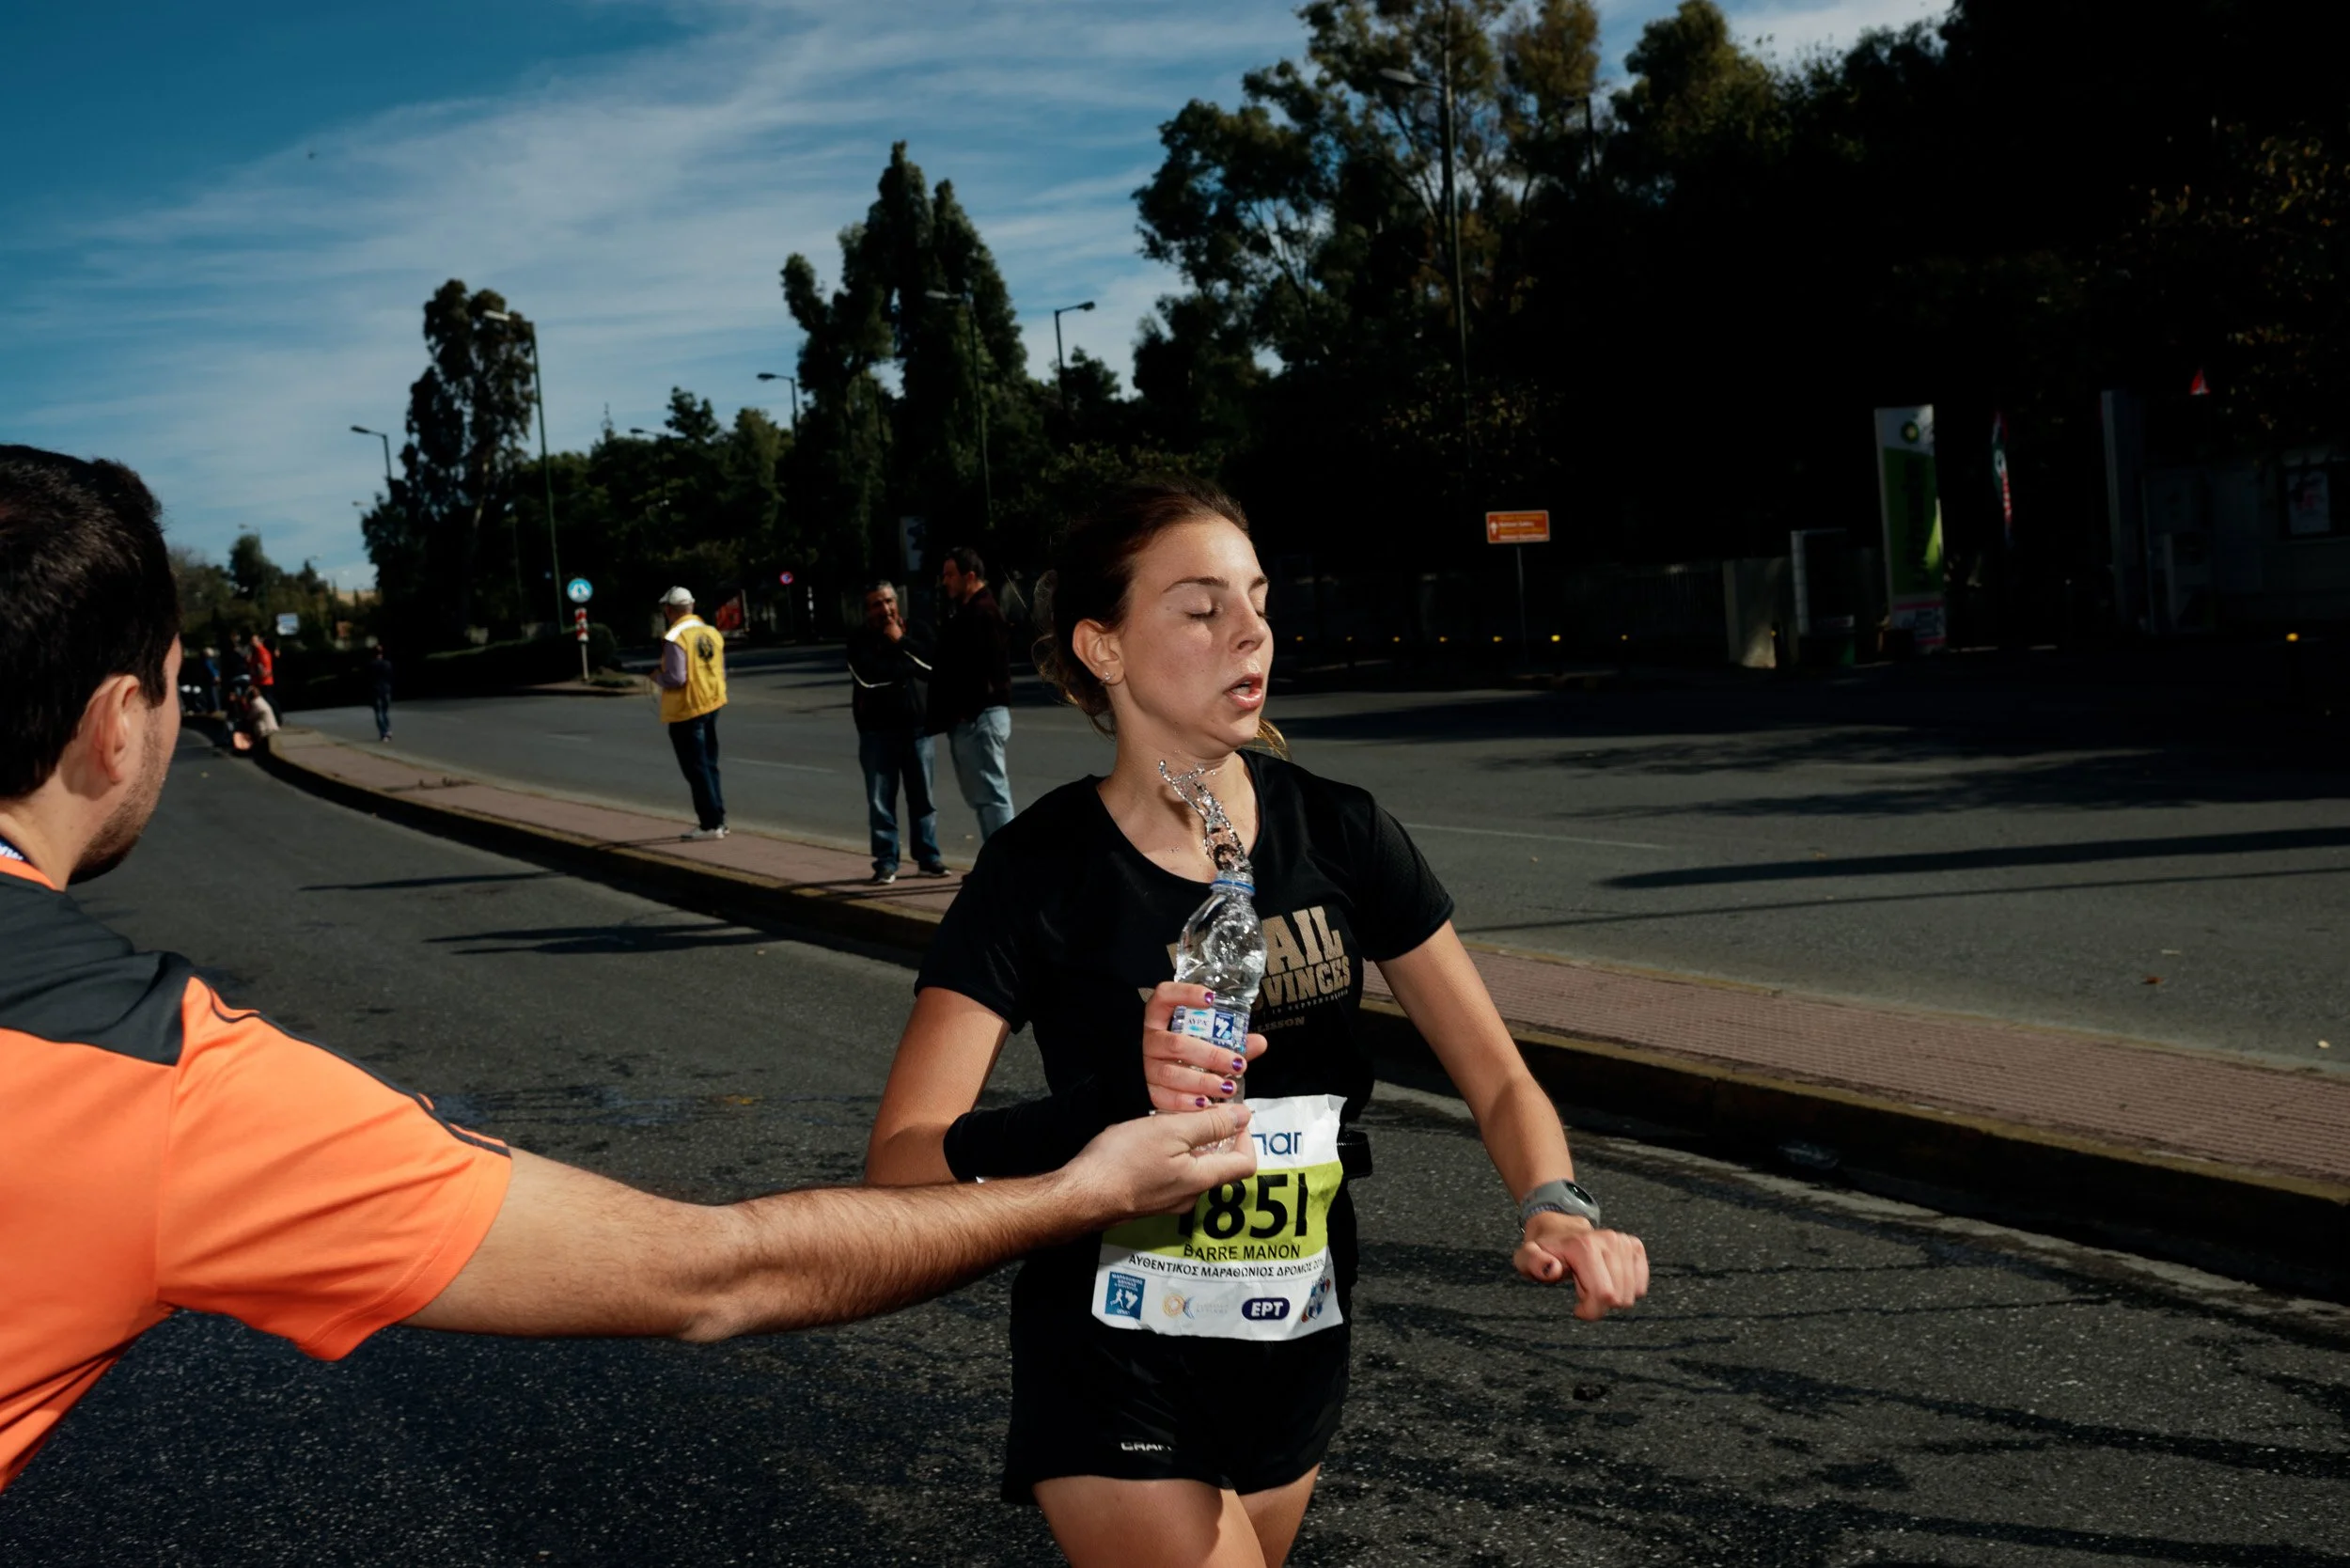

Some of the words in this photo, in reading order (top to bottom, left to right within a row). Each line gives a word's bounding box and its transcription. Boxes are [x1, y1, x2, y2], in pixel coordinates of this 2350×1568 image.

[1183, 1243, 1238, 1262] BARRE
[1243, 1244, 1301, 1261] MANON
[1128, 1254, 1199, 1278] ΑΥΘΕΝΤΙΚΟΣ
[1200, 1266, 1275, 1278] ΜΑΡΑΘΩΝΙΟΣ
[1250, 1301, 1284, 1318] ΕΡΤ
